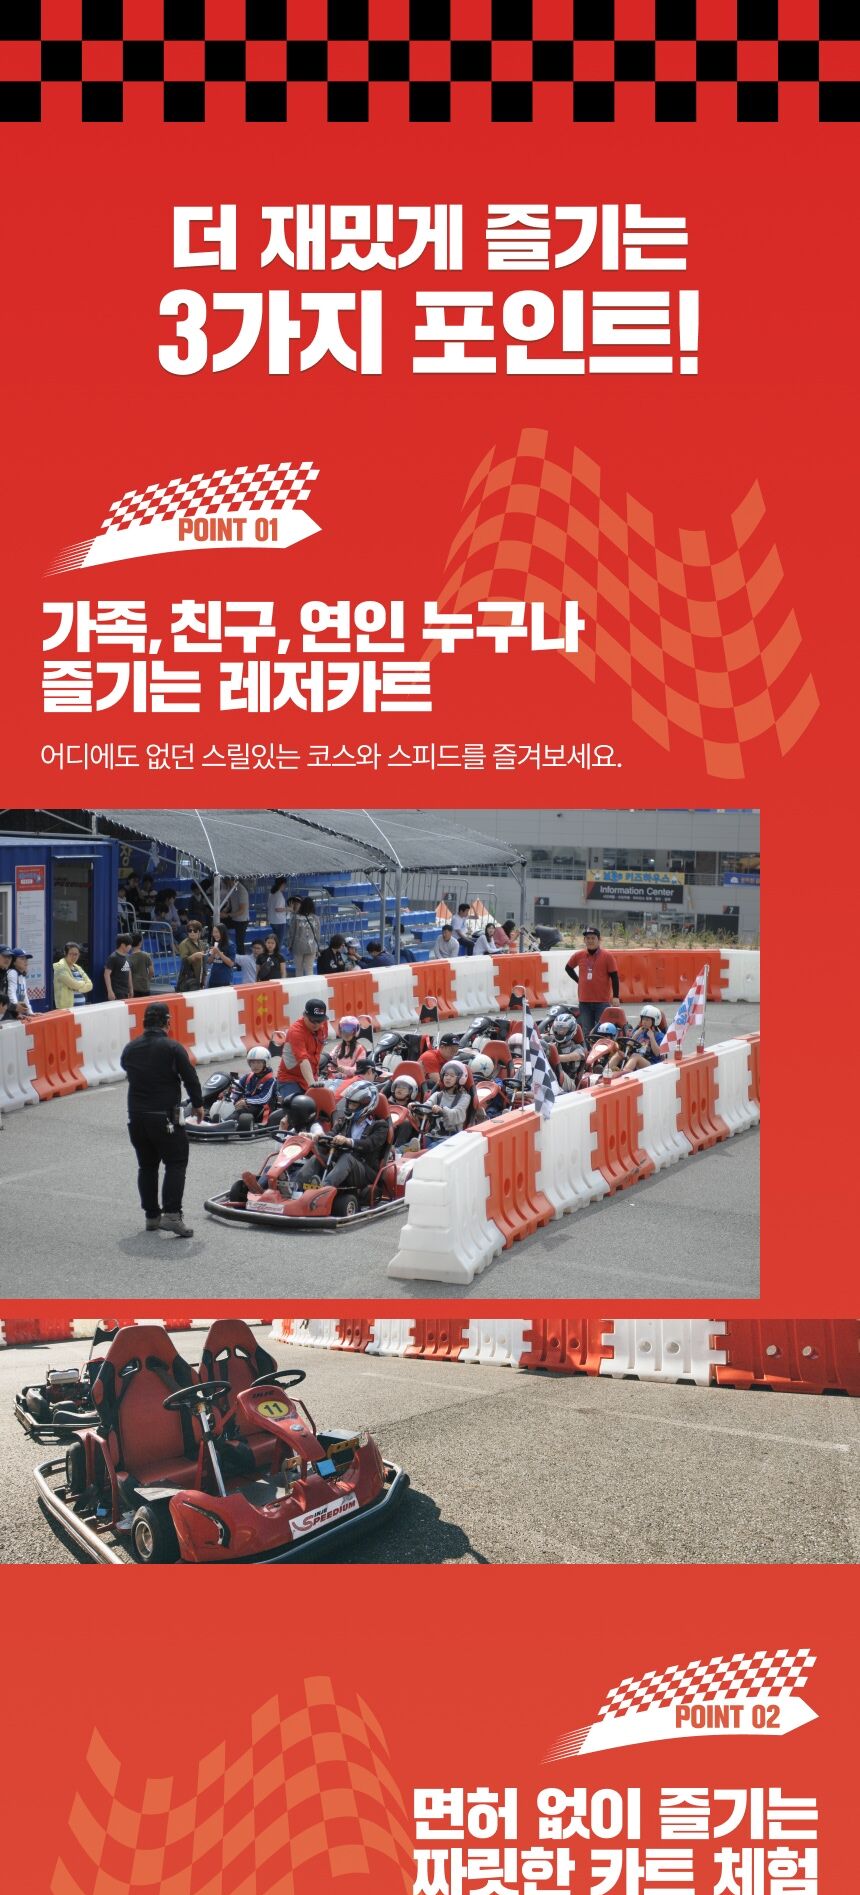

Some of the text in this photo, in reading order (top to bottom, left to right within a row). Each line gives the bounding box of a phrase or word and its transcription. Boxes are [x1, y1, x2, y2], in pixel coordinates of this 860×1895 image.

[600, 886, 674, 896] Information Center
[380, 1033, 393, 1044] 2
[209, 1073, 223, 1085] 9
[263, 1403, 283, 1415] 11
[292, 1500, 356, 1531] SPEEDIUM
